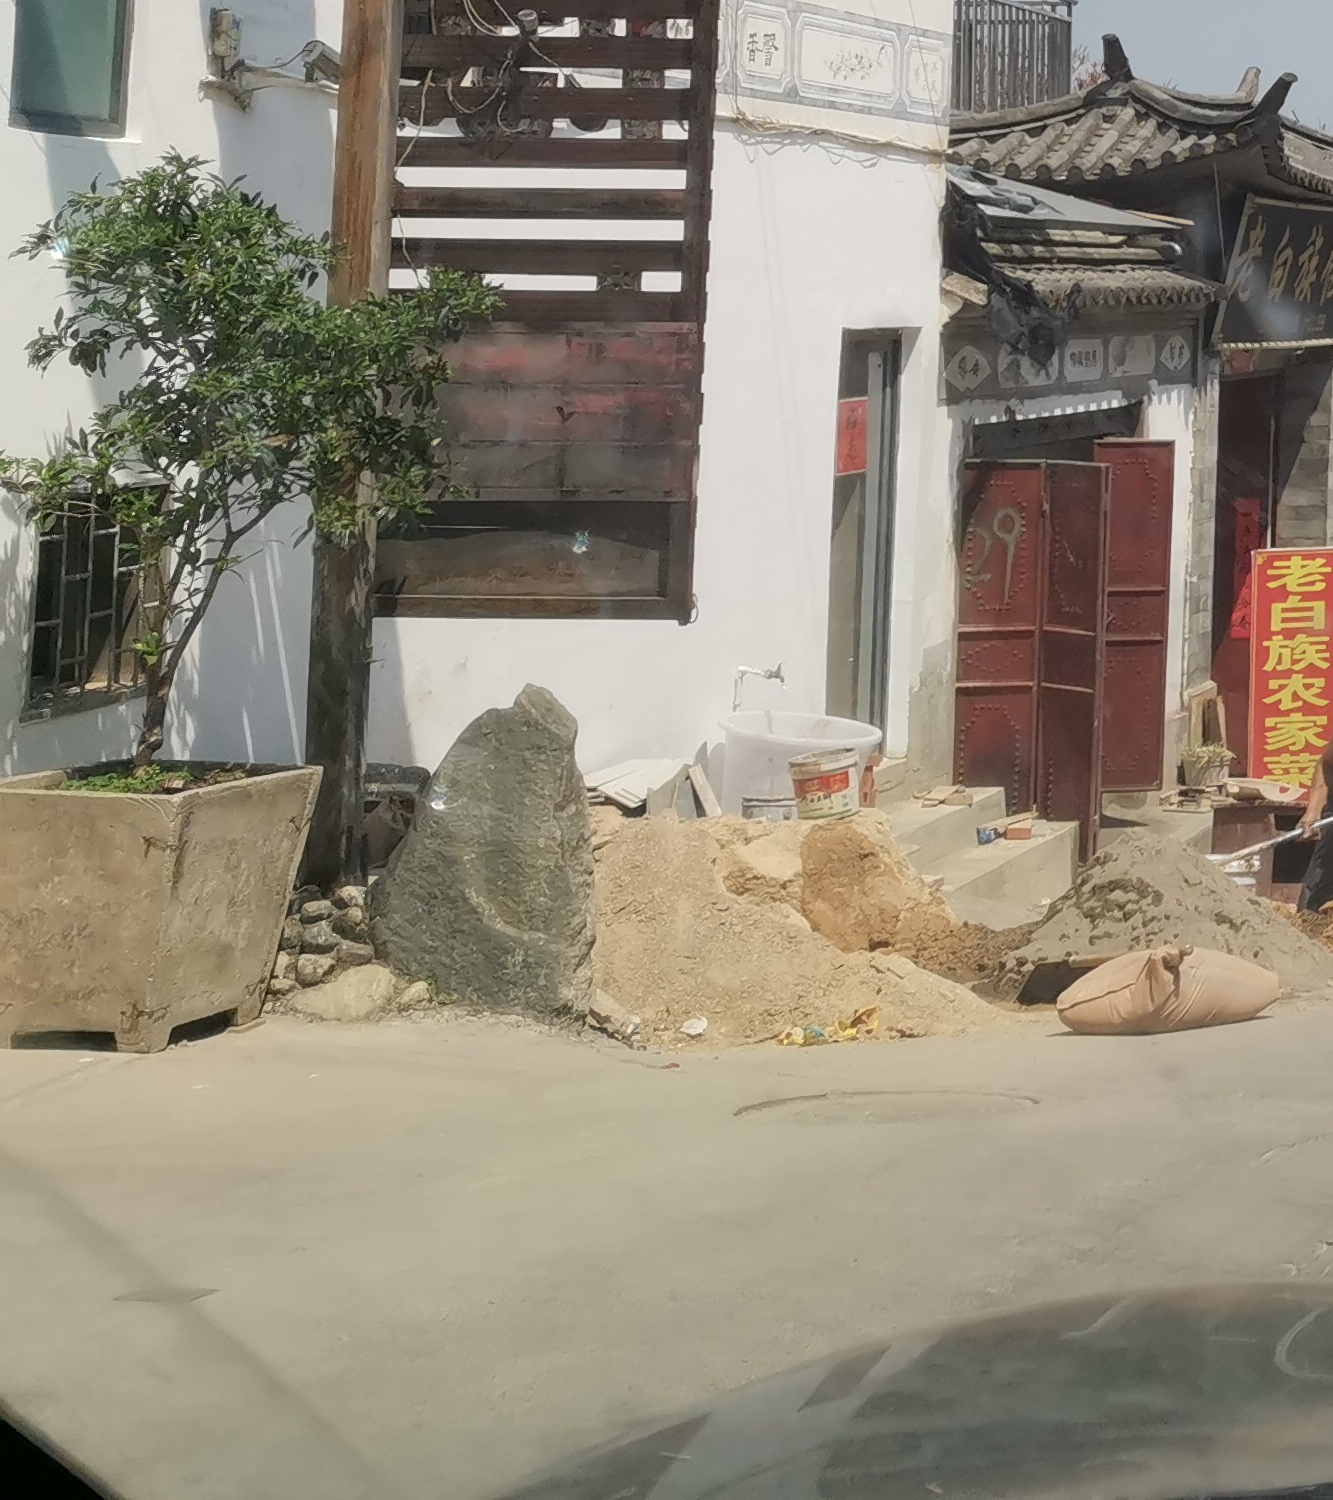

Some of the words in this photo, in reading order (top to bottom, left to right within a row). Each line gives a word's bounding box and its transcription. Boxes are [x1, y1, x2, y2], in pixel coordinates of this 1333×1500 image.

[1262, 555, 1332, 788] 老白族农家菜
